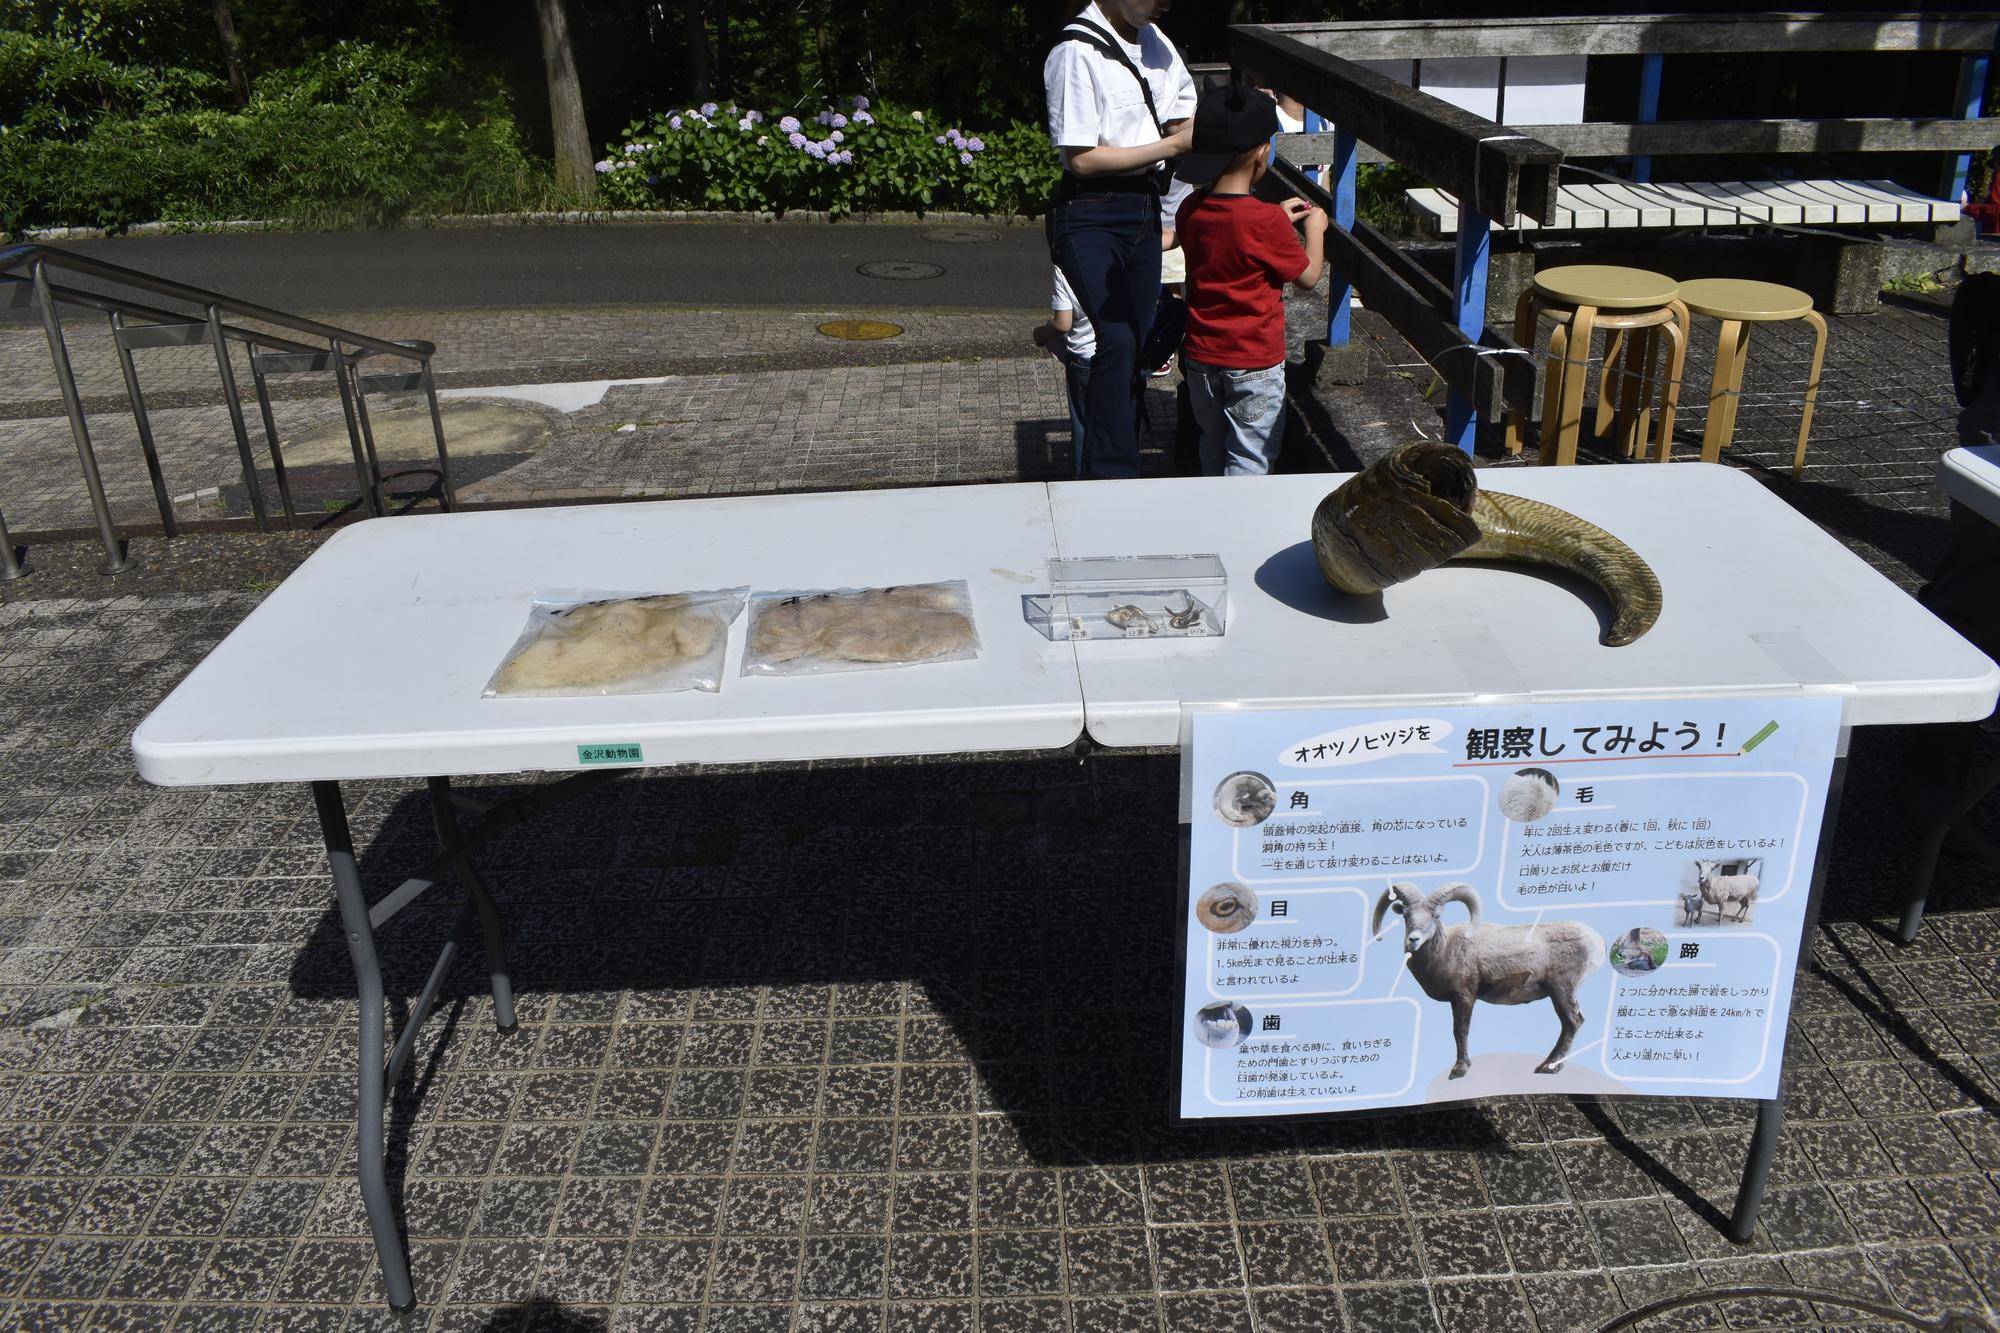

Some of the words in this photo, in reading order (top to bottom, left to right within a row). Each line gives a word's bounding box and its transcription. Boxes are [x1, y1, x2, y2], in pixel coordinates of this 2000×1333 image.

[1294, 723, 1432, 764] オオツノヒツジを
[1466, 721, 1726, 761] 観察してみよう！
[582, 748, 640, 760] 金沢動物園
[1289, 790, 1309, 810] 角
[1575, 786, 1594, 803] 毛
[1271, 900, 1288, 917] 目
[1679, 942, 1700, 960] 蹄
[1216, 974, 1300, 986] と言われているよ
[1262, 1014, 1281, 1031] 歯
